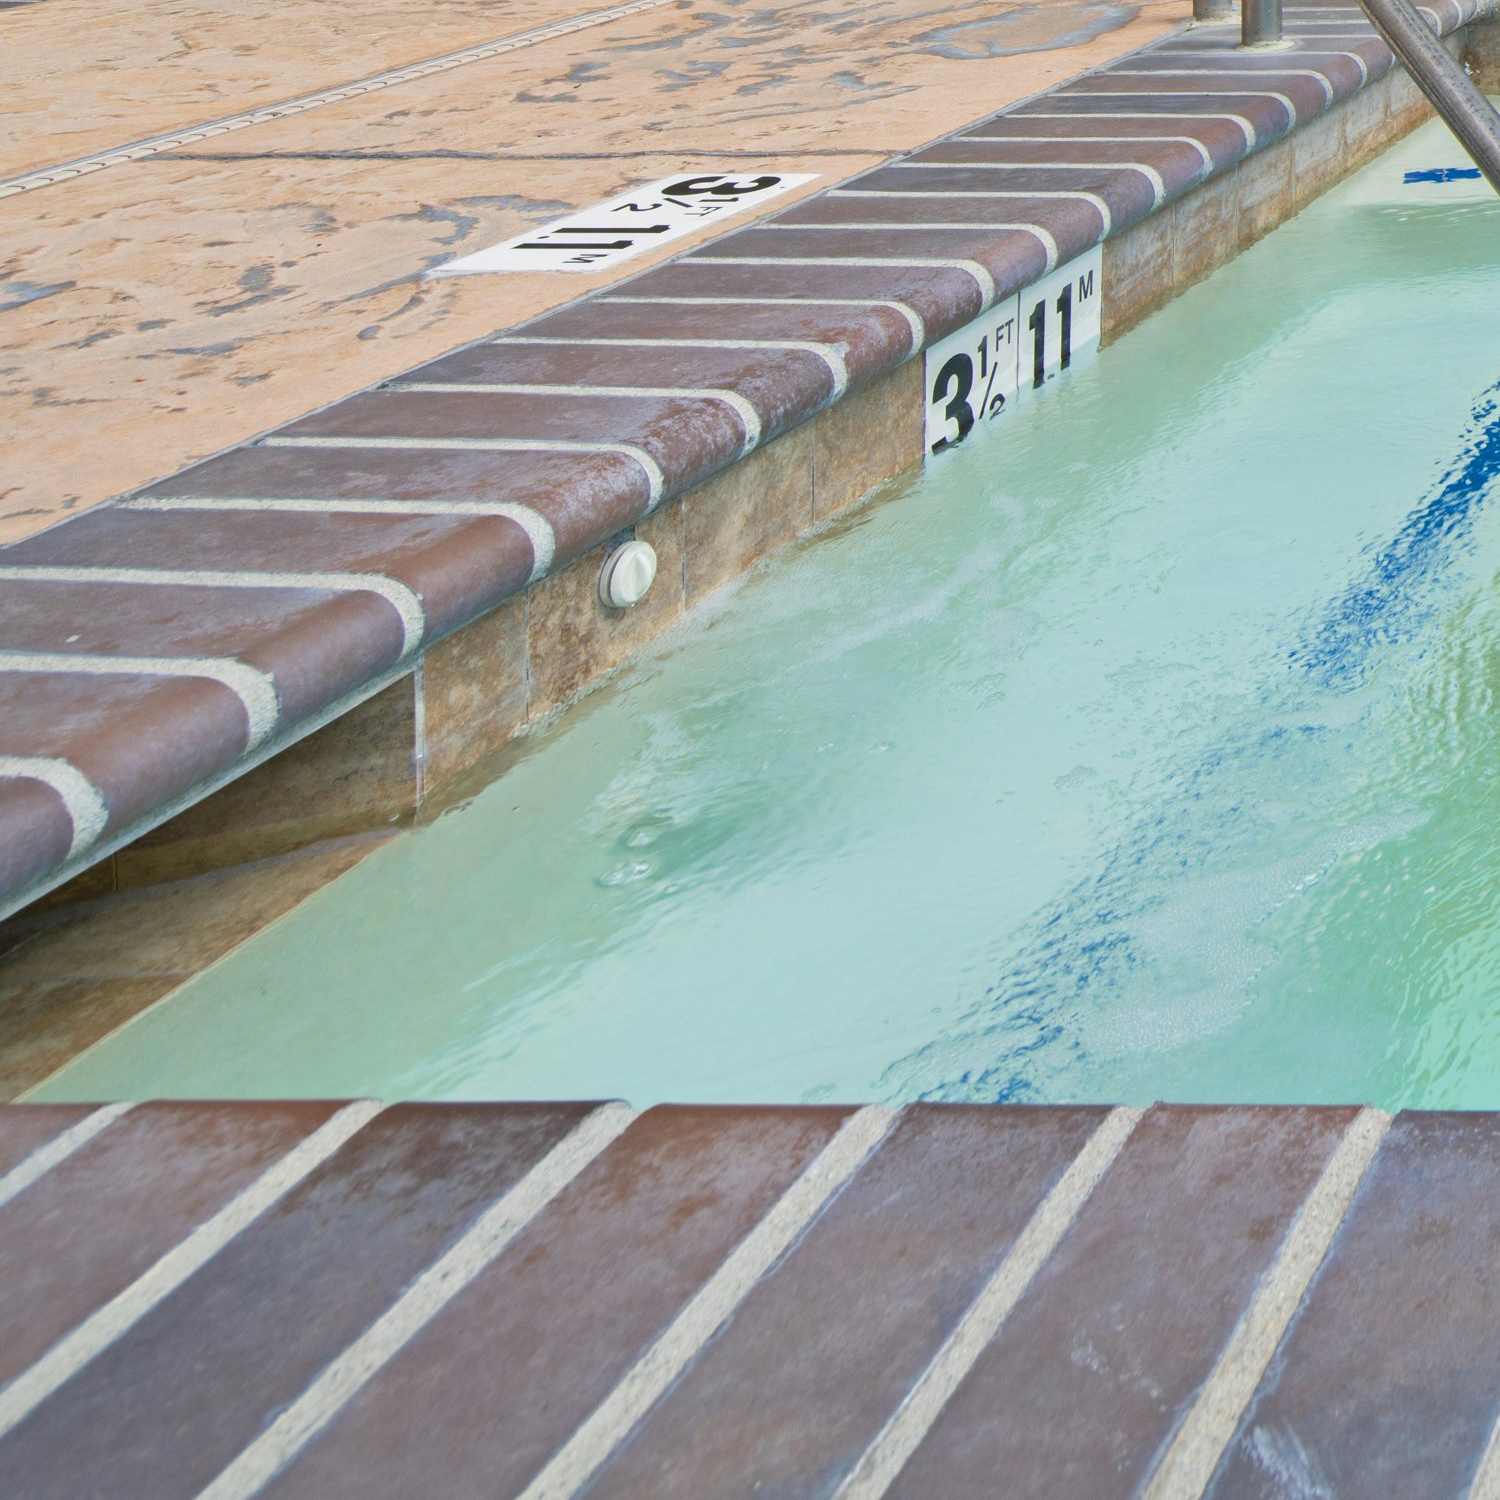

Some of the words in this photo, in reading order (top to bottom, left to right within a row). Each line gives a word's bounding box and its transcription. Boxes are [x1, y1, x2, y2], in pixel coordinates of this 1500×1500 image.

[562, 253, 610, 264] M
[995, 317, 1014, 353] FT
[1079, 269, 1093, 303] M
